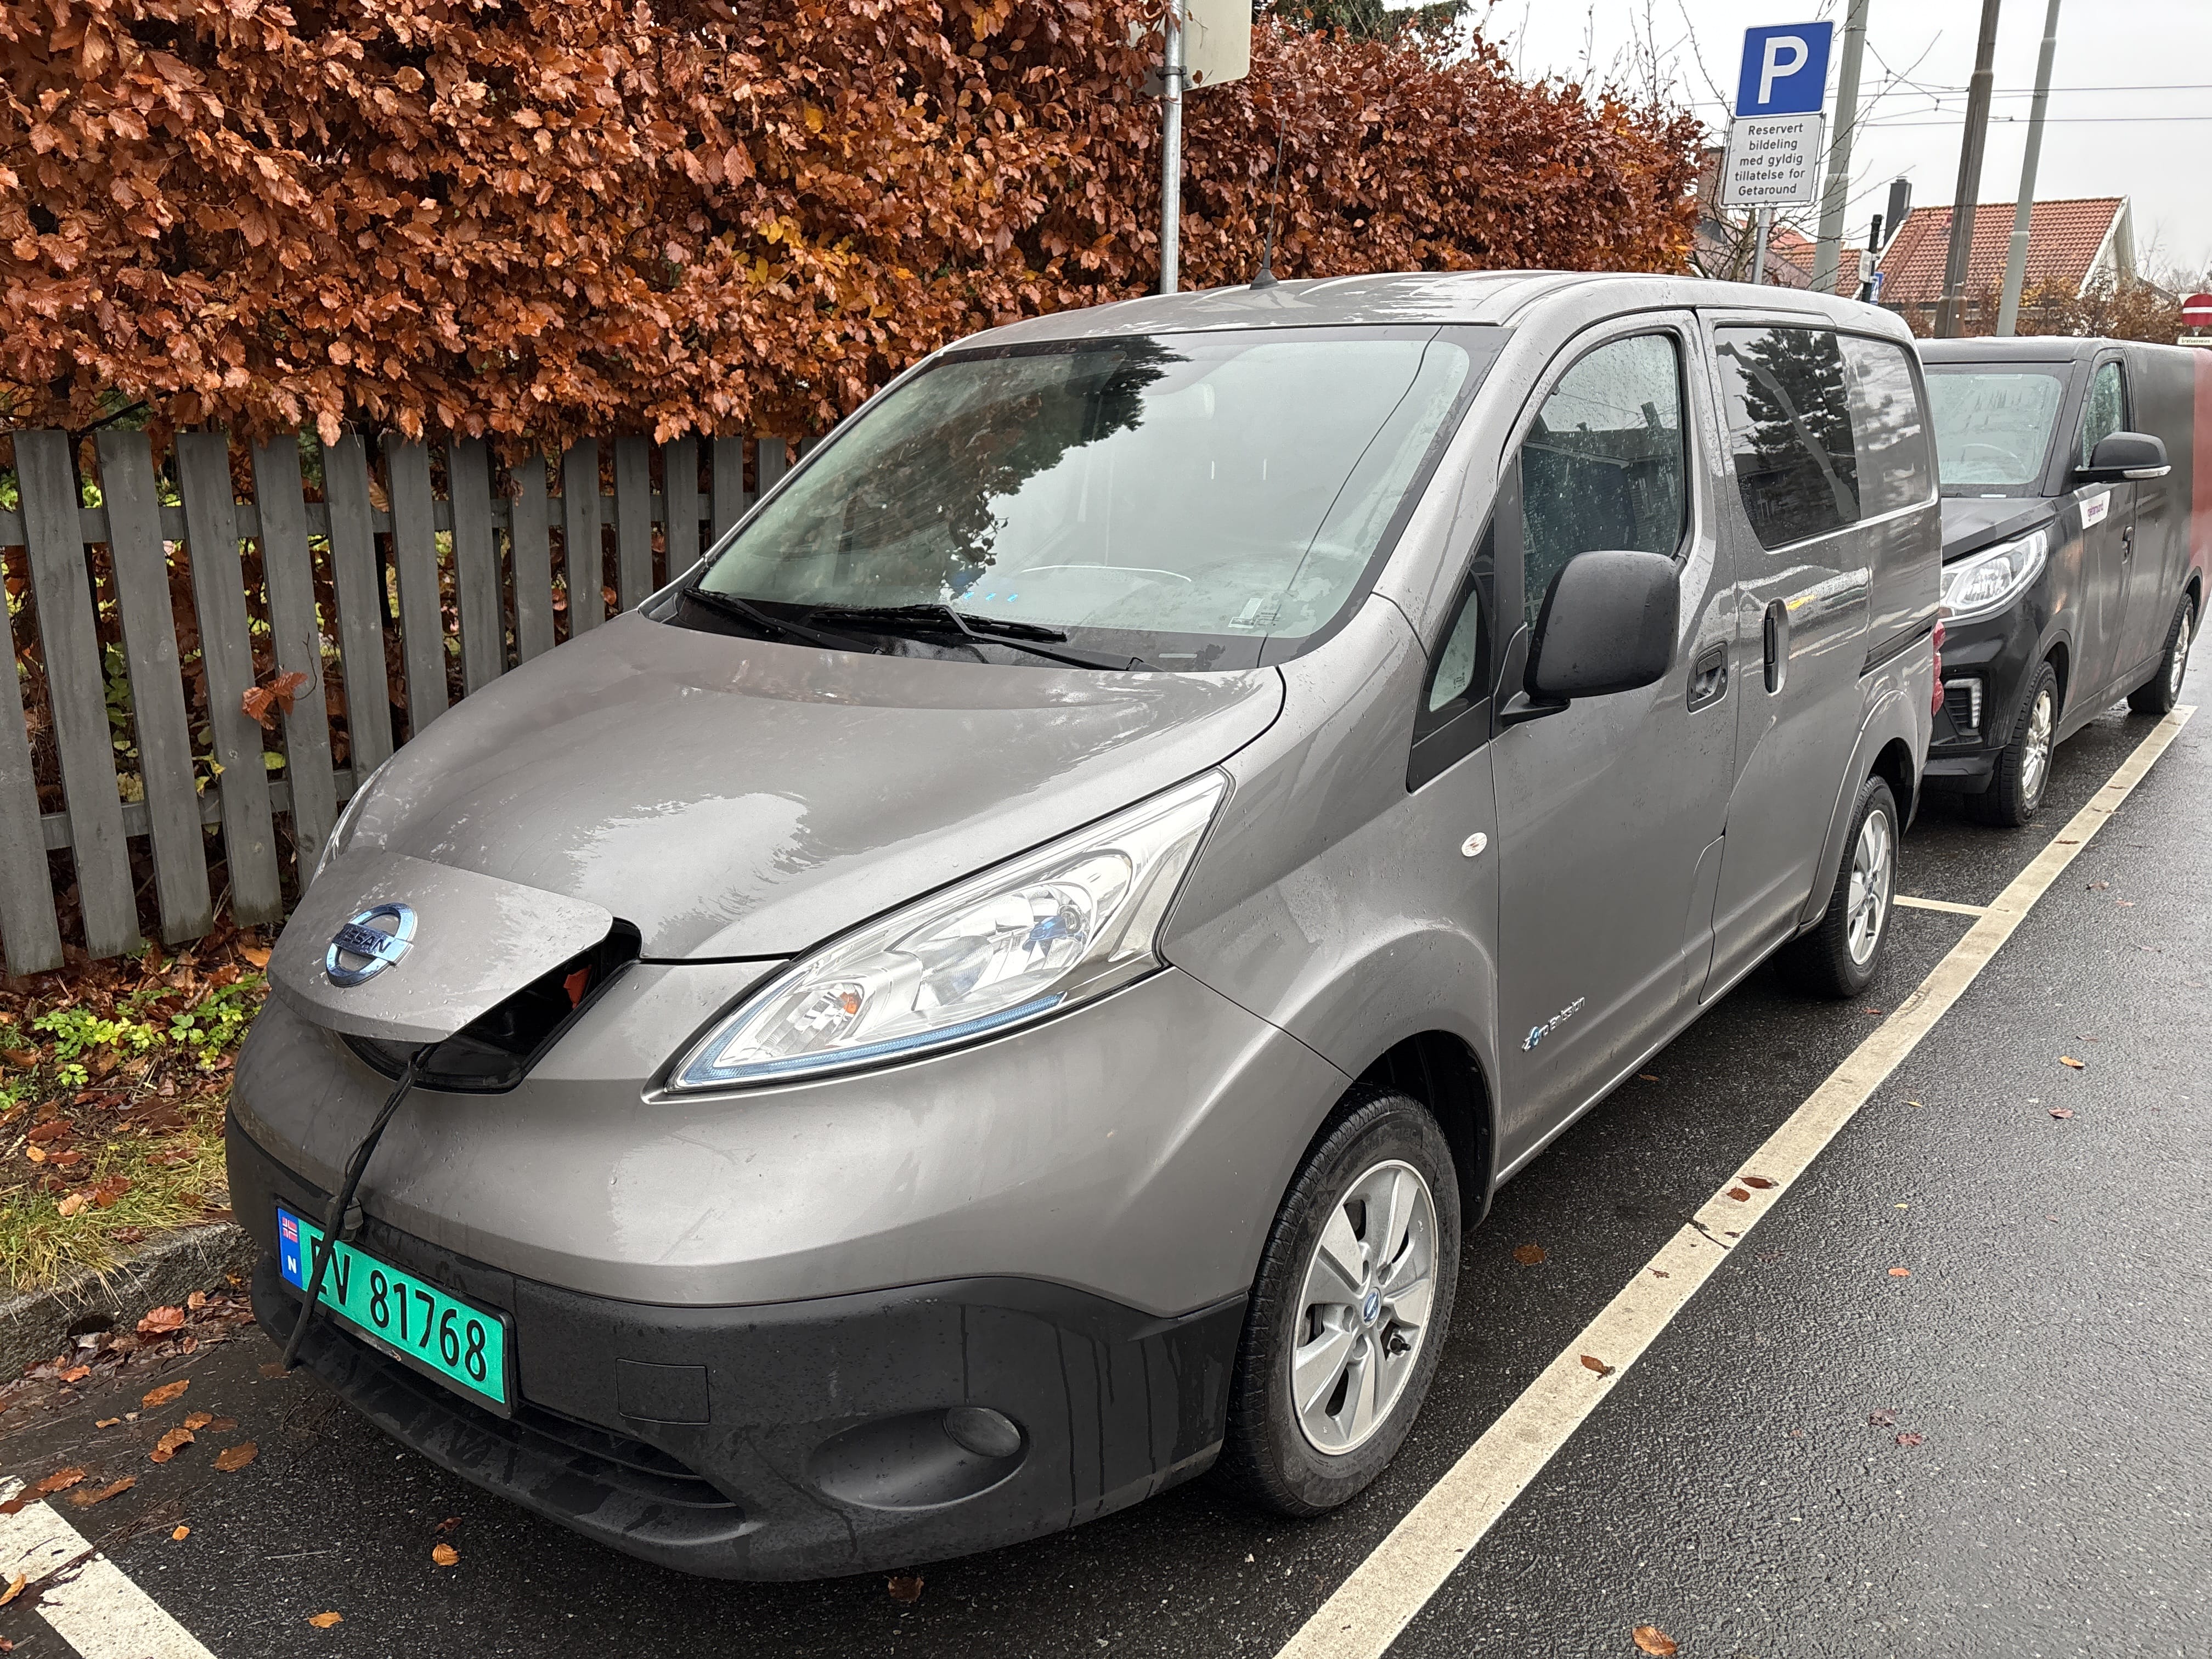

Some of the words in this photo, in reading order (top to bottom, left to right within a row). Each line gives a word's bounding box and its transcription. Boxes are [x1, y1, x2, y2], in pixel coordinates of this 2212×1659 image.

[1758, 36, 1808, 104] P
[1748, 123, 1803, 136] Reservert
[1749, 138, 1798, 151] bildeling
[1740, 155, 1763, 166] med
[1768, 153, 1803, 167] gyldig
[1735, 170, 1784, 182] tillatelse
[1789, 168, 1805, 179] for
[1739, 183, 1797, 196] Getaround
[287, 1255, 297, 1274] N
[370, 1269, 487, 1382] 81768
